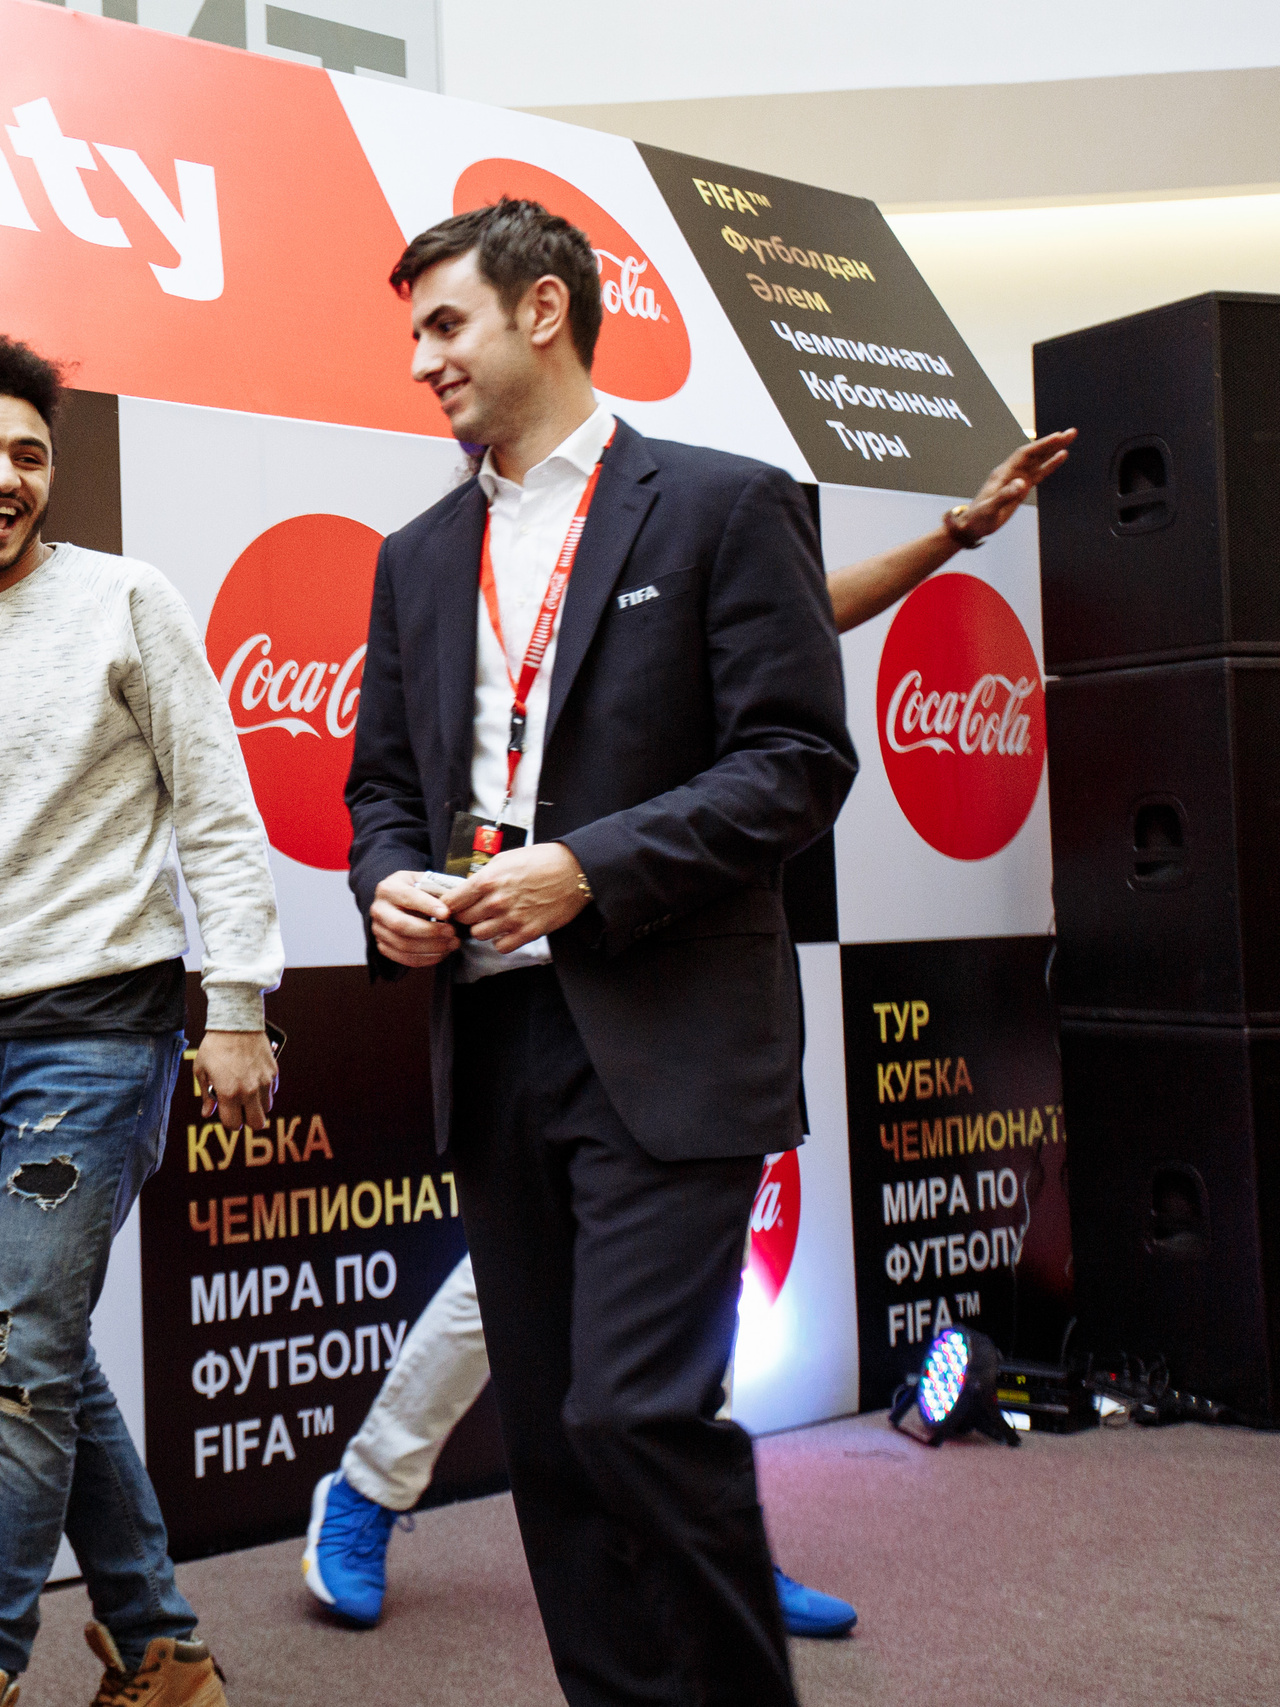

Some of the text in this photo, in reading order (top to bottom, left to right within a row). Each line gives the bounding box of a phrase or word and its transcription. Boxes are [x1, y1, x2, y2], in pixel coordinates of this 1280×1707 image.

[691, 177, 773, 218] FIFA™
[721, 225, 877, 283] Футболдан
[746, 272, 832, 314] Әлем
[770, 320, 955, 377] Чемпионаты
[799, 369, 974, 428] Кубогының
[826, 419, 912, 463] Туры
[617, 584, 660, 609] FIFA
[219, 633, 368, 741] Coca-C
[886, 669, 1037, 756] Coca-Cola
[873, 1000, 930, 1043] ТУР
[877, 1056, 974, 1104] КУБКА
[187, 1114, 334, 1173] КУБКА
[879, 1104, 1067, 1162] ЧЕМПИОНАТ
[188, 1171, 459, 1246] ЧЕМПИОНАТ
[882, 1167, 1019, 1226] МИРА ПО
[885, 1224, 1026, 1285] ФУТБОЛУ
[190, 1250, 398, 1326] МИРА ПО
[191, 1320, 408, 1400] ФУТБОЛУ
